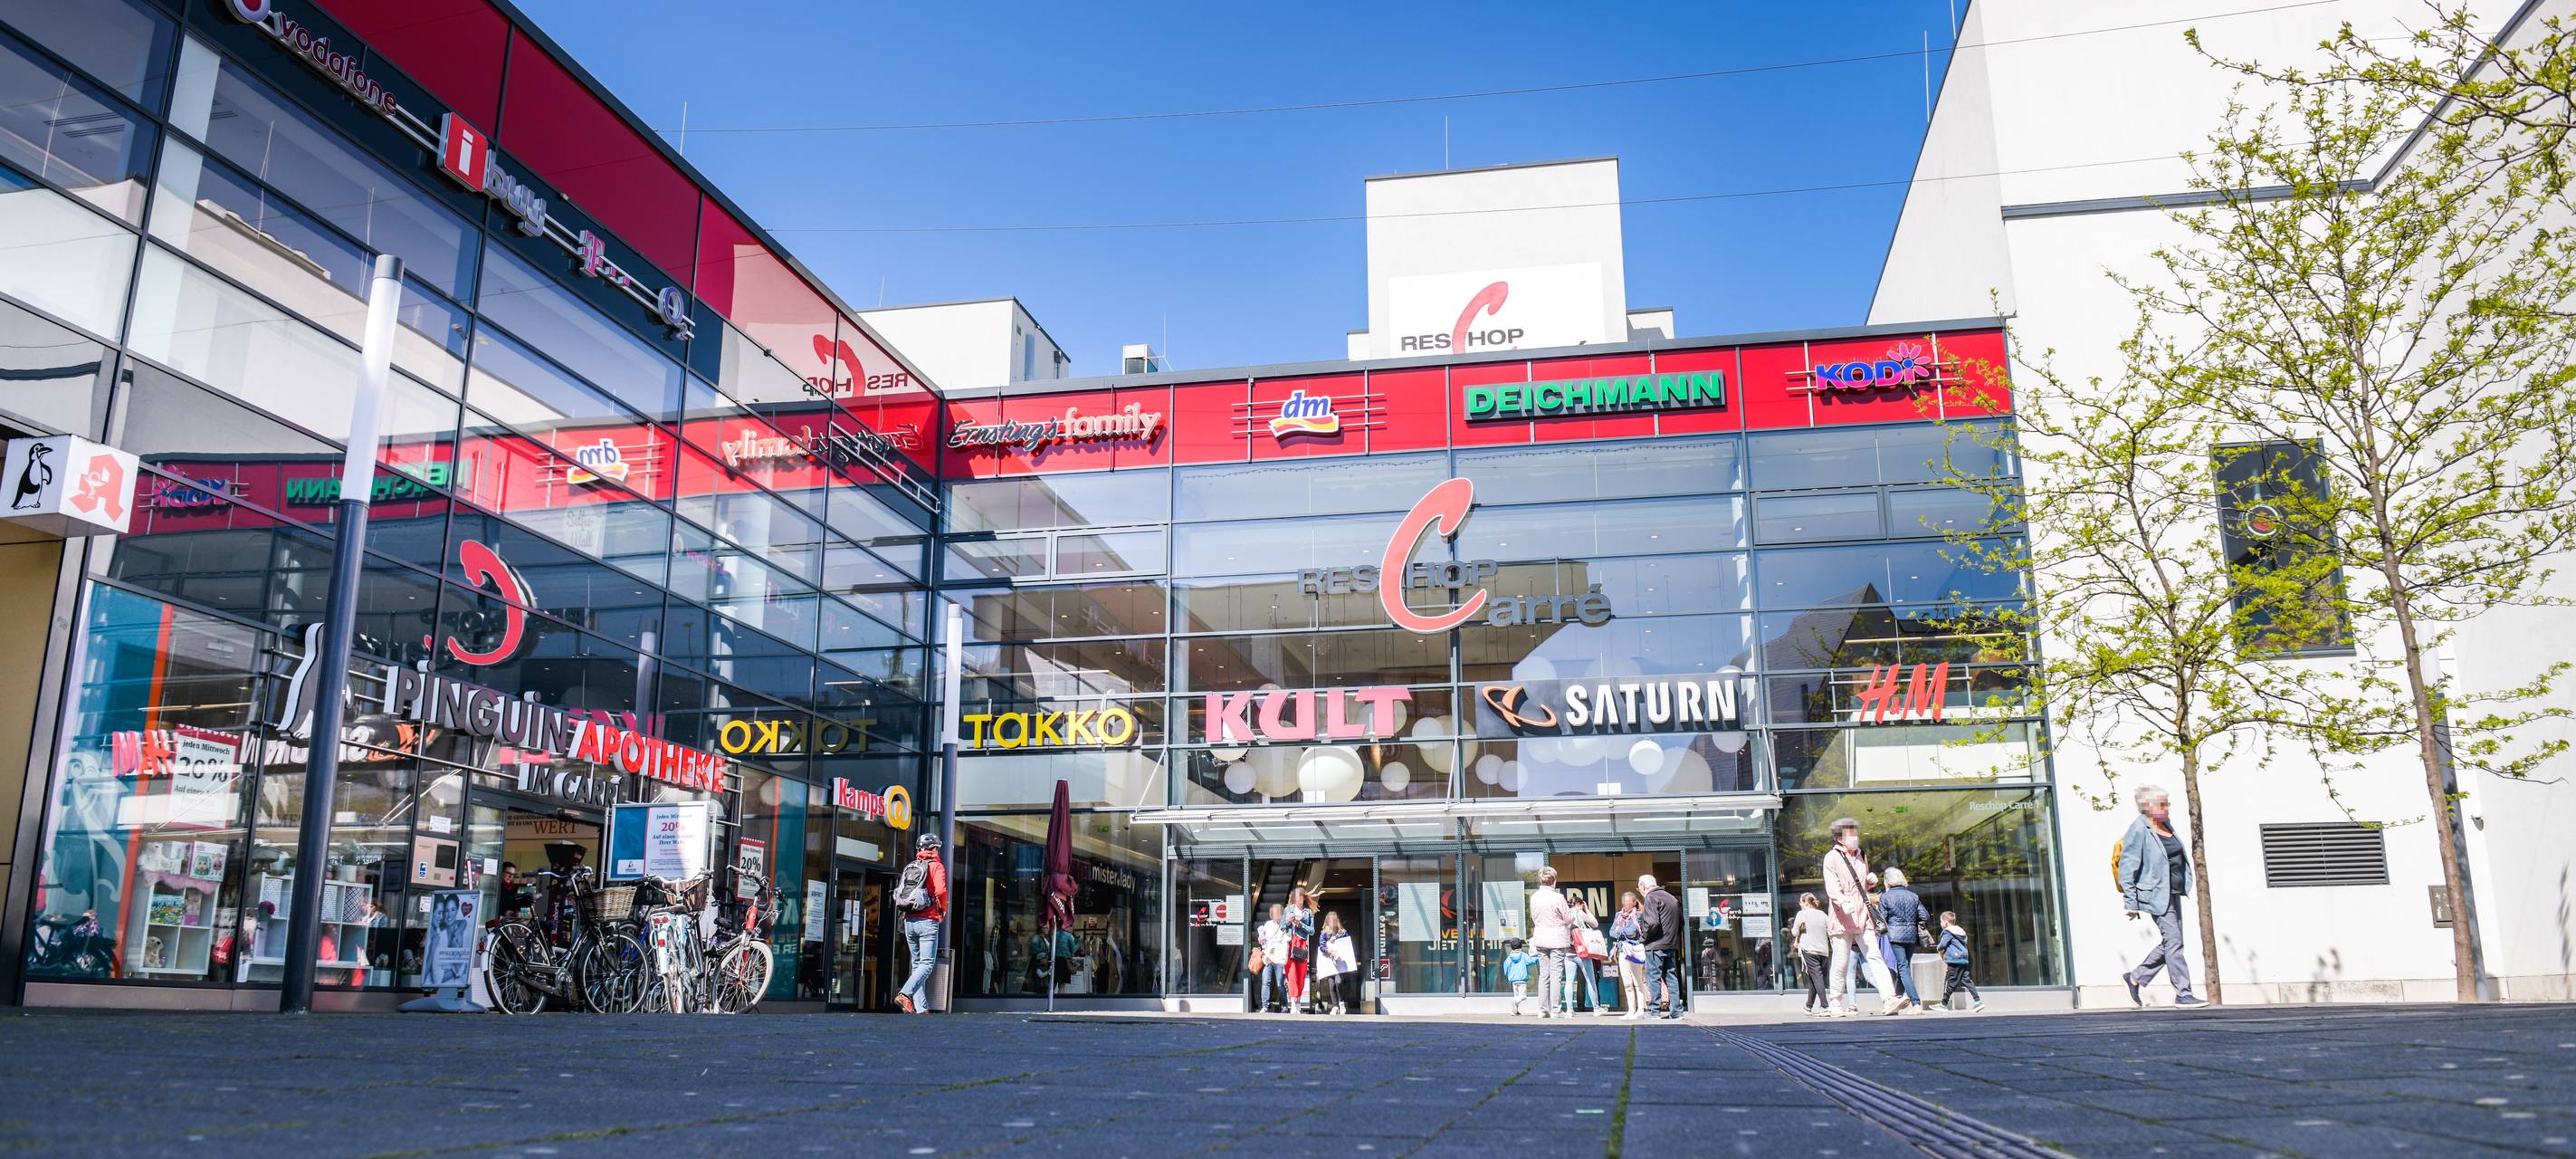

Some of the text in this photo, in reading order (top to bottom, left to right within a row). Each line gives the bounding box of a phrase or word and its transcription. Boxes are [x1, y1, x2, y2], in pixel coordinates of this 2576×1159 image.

[273, 11, 398, 116] vodafone
[483, 148, 547, 237] buy
[1282, 390, 1331, 418] dm
[1467, 372, 1722, 415] DEICHMANN
[947, 402, 1162, 451] Ernsting's family
[1566, 679, 1737, 726] SATURN
[1856, 662, 1949, 724] H&M
[1206, 687, 1413, 742] KULT
[182, 740, 230, 755] jeden Mittwoch
[568, 720, 725, 793] APOTHEKE
[178, 756, 227, 782] 20%
[518, 762, 554, 794] IM
[834, 777, 885, 821] Kamps
[2009, 800, 2034, 809] Carré
[533, 820, 578, 834] WERT
[661, 822, 685, 832] 20%
[740, 857, 761, 871] 20%
[1120, 868, 1137, 894] lady
